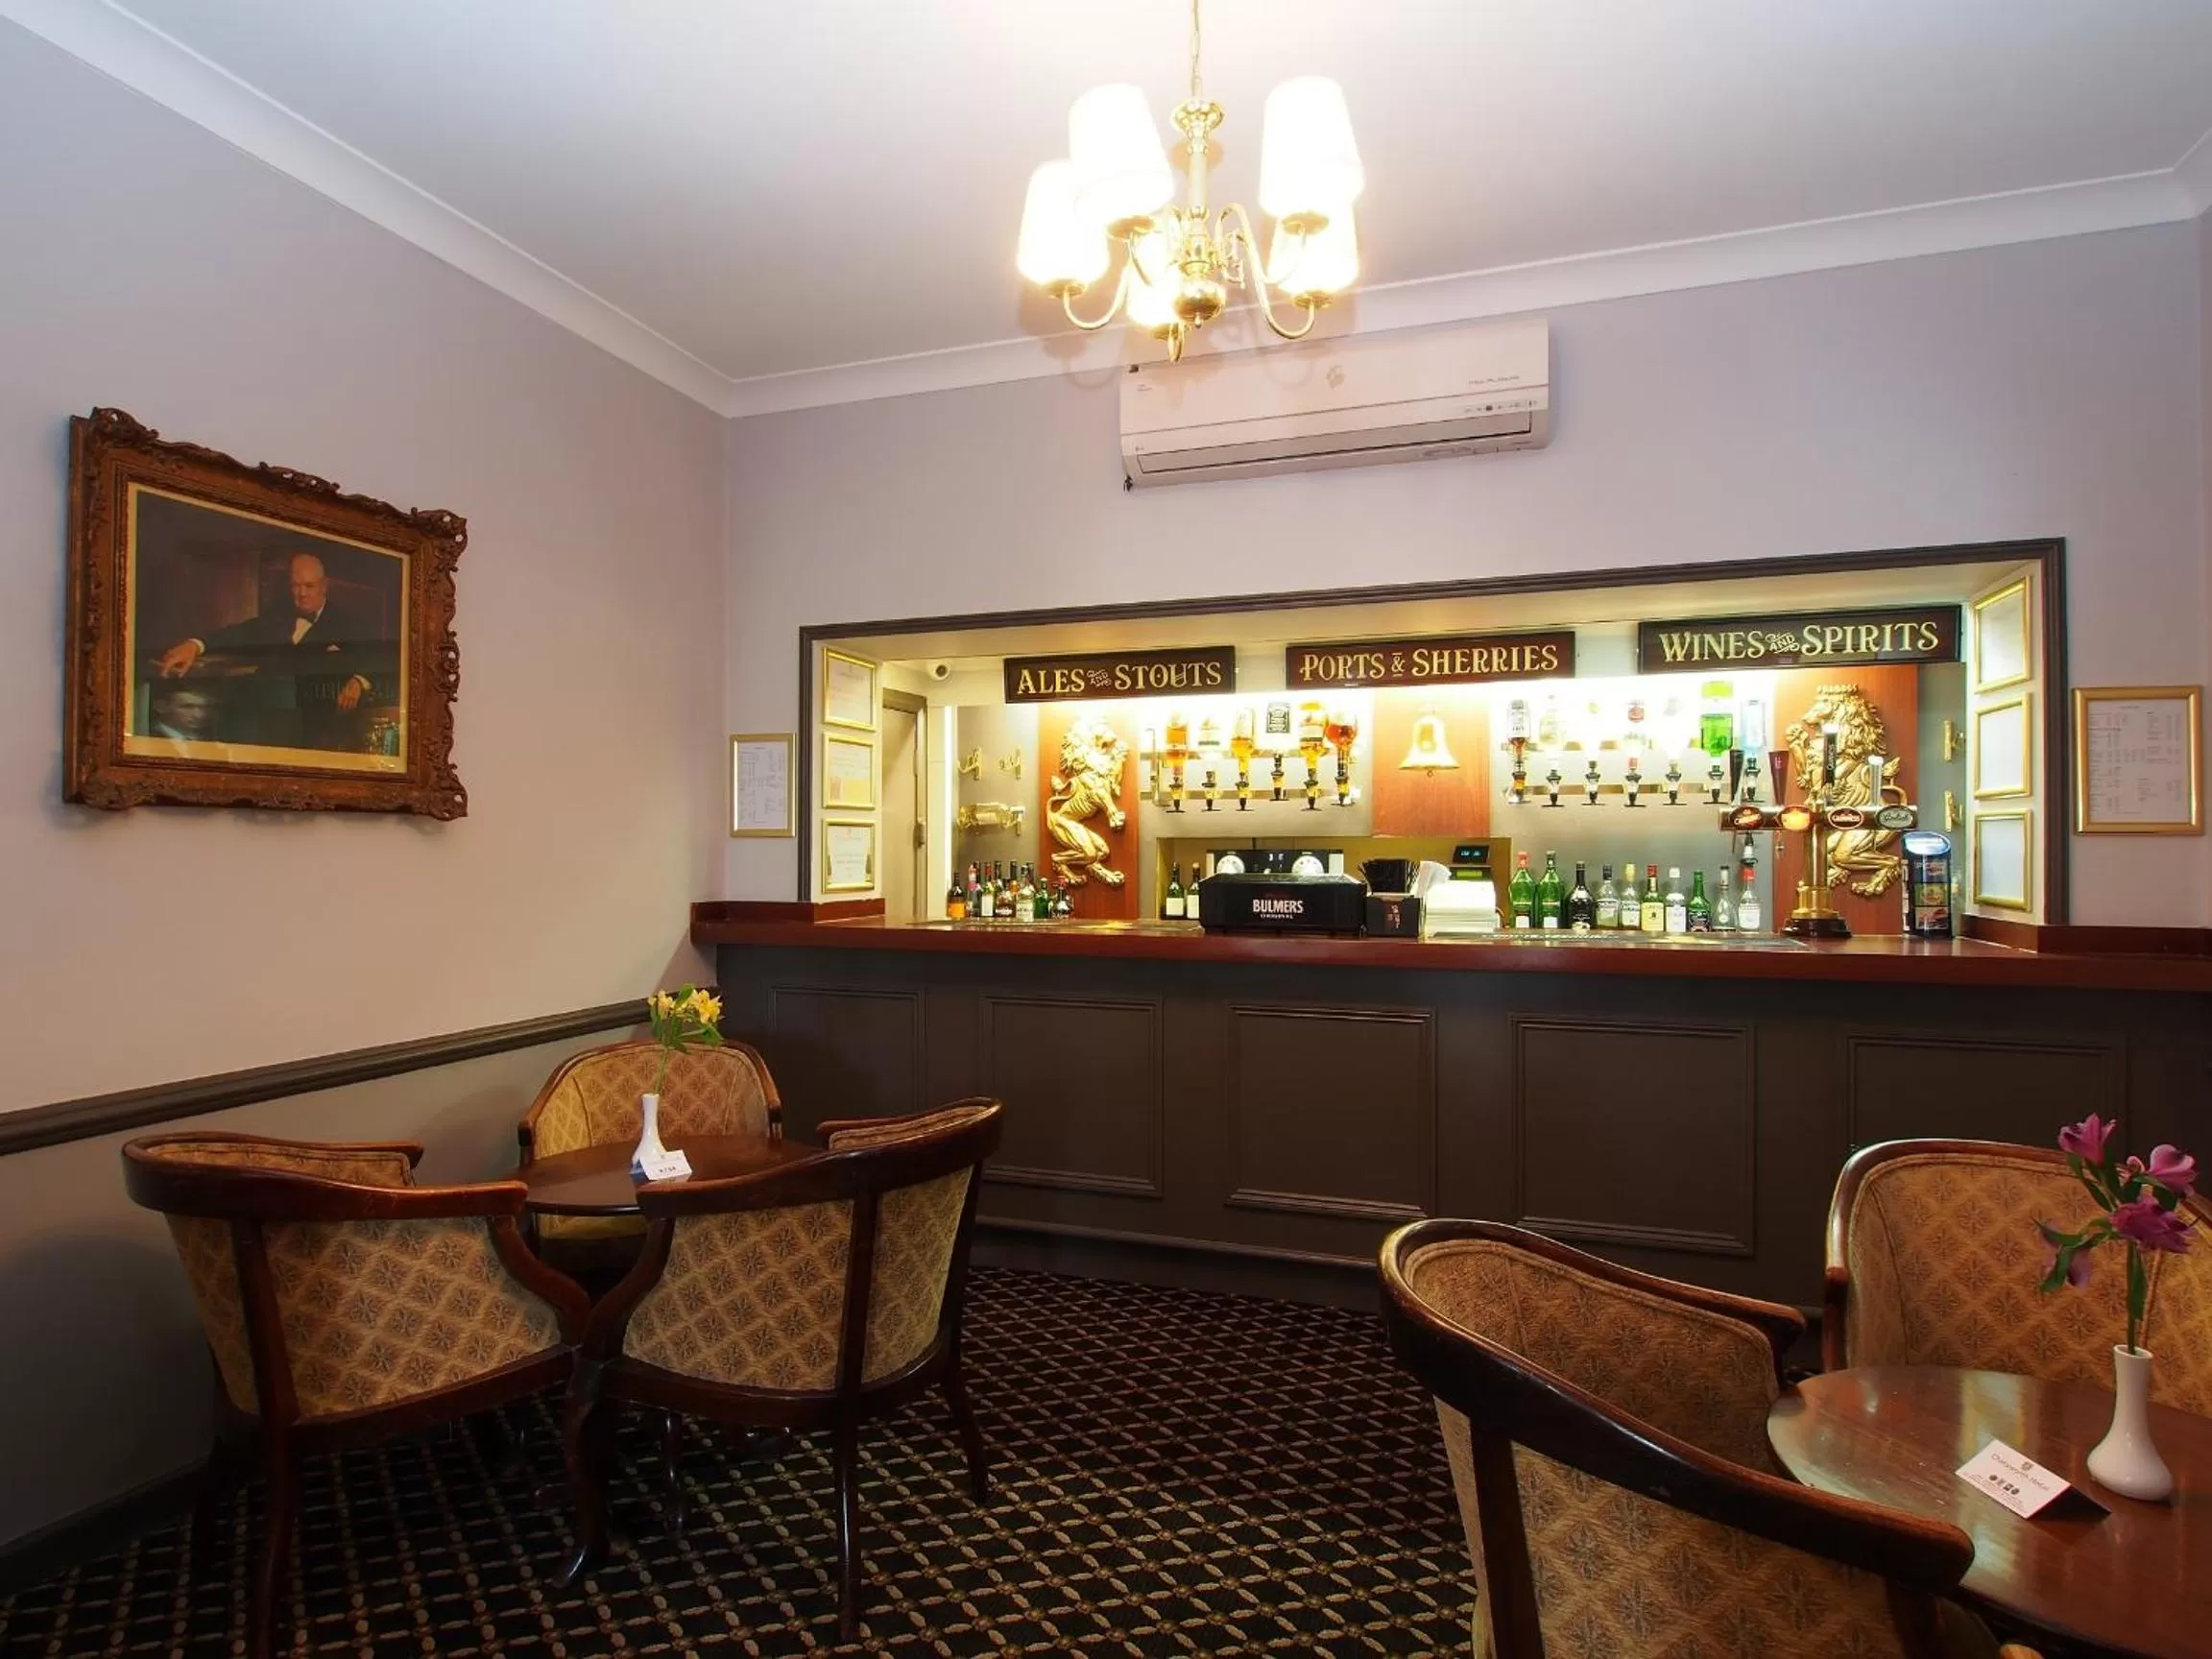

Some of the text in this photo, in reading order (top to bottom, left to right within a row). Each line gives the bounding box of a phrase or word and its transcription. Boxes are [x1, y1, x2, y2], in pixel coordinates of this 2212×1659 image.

[1659, 621, 1939, 662] WINES AND SPIRITS
[1017, 668, 1086, 694] ALES
[1114, 661, 1221, 690] STOUTS
[1300, 644, 1558, 681] PORTS & SHERRIES
[1252, 899, 1304, 913] BULMERS
